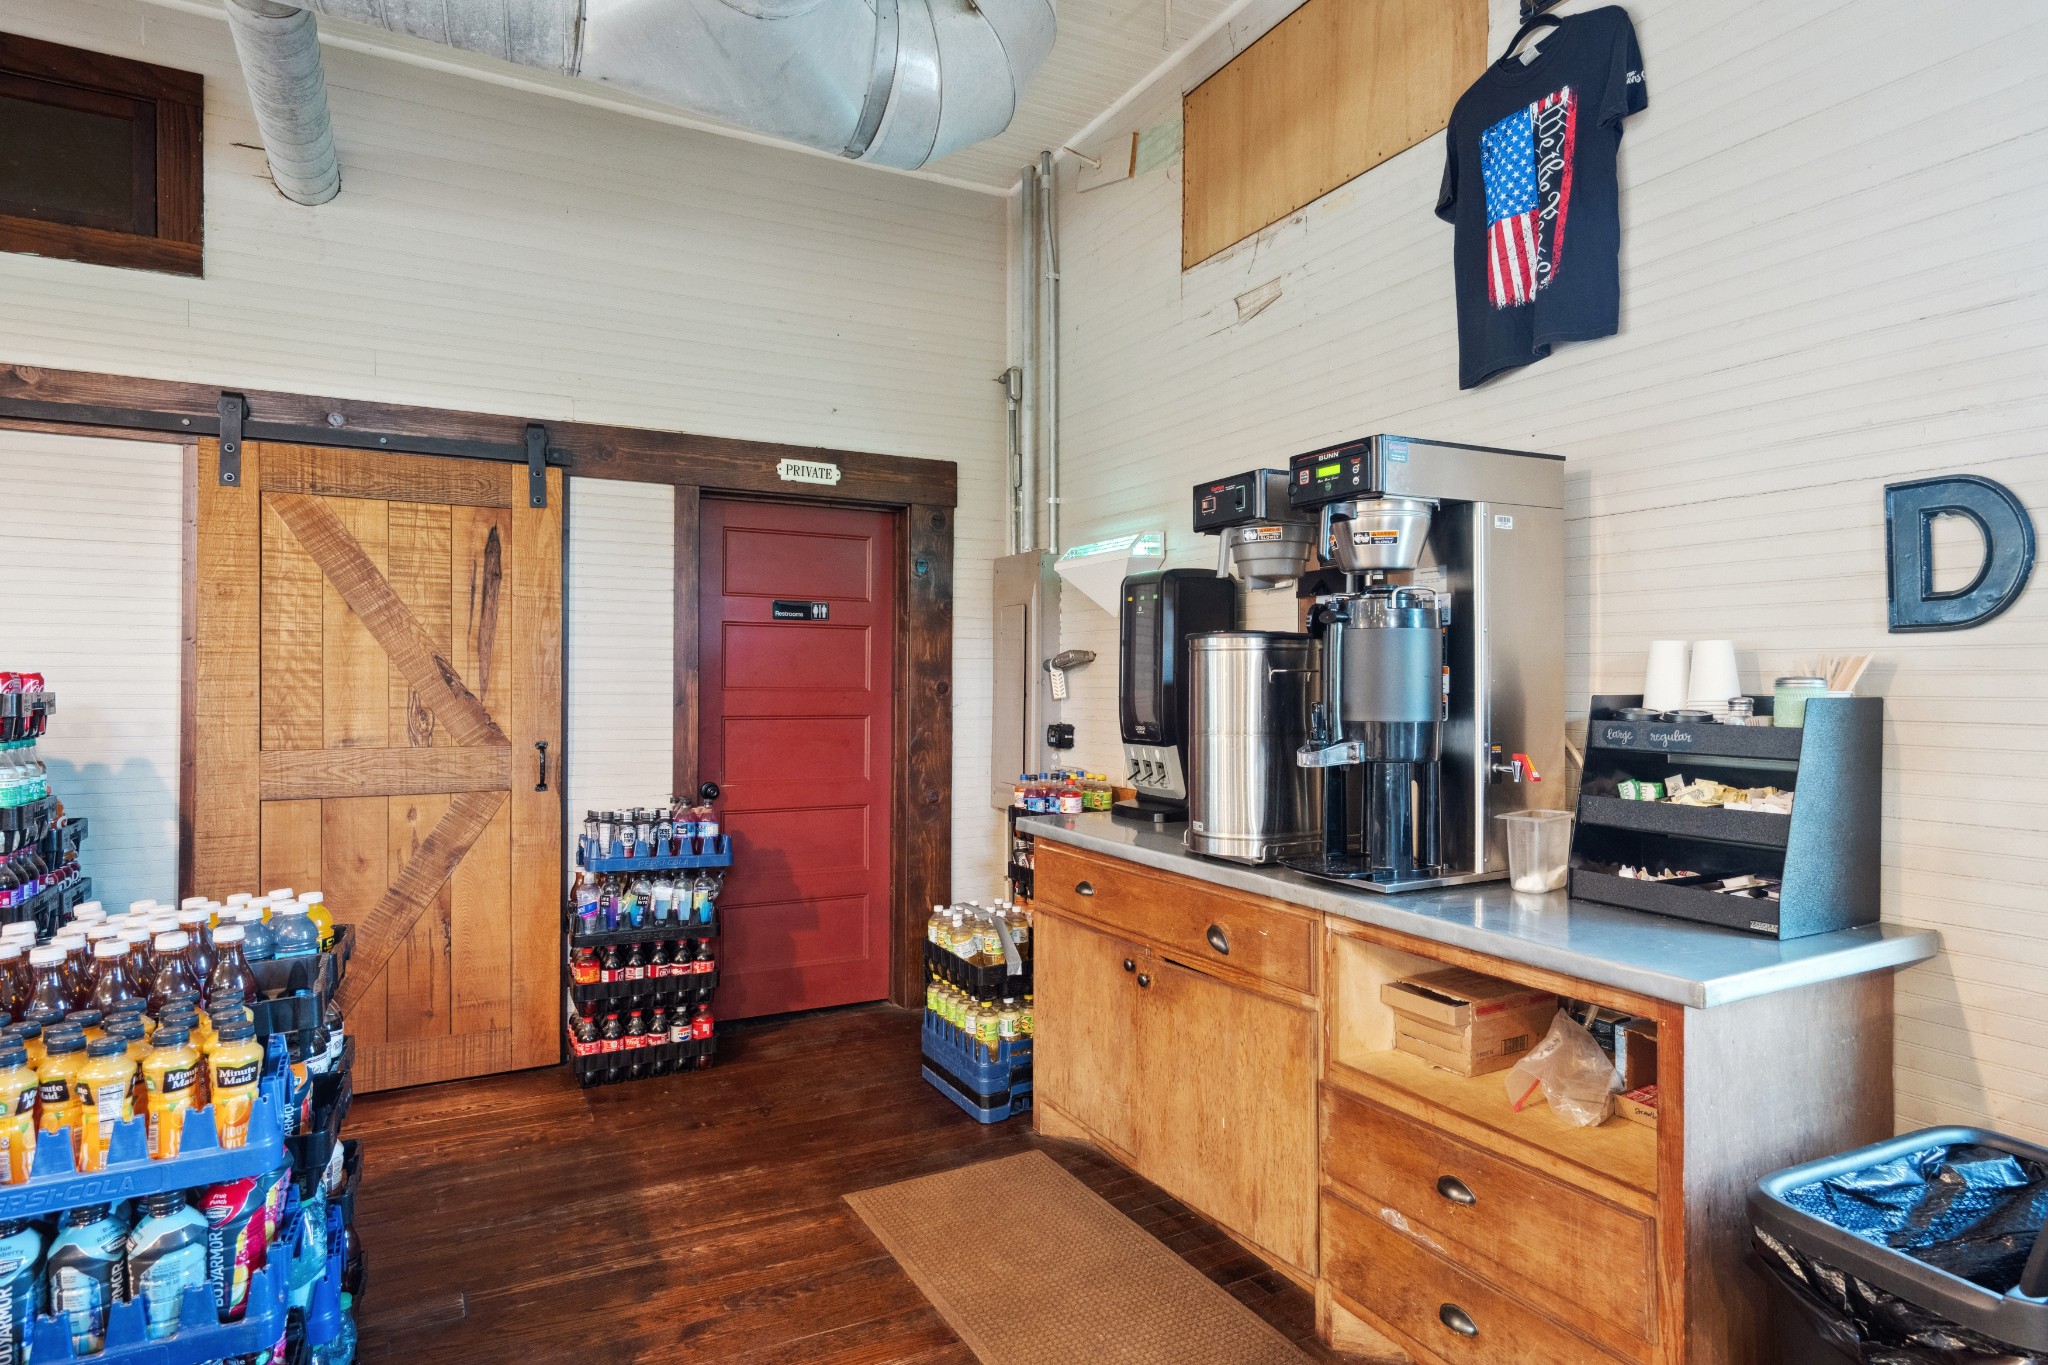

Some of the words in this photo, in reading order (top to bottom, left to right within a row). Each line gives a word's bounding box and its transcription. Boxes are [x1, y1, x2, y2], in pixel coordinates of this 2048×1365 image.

[1318, 452, 1339, 461] BUNN
[785, 463, 833, 480] PRIVATE
[1884, 474, 2036, 633] D
[1607, 728, 1634, 745] large
[1649, 729, 1692, 748] regular
[219, 1066, 257, 1078] Minute
[224, 1075, 253, 1086] Maid
[41, 1092, 60, 1100] aid
[97, 1226, 125, 1243] Raspberry
[102, 1224, 117, 1233] Blue
